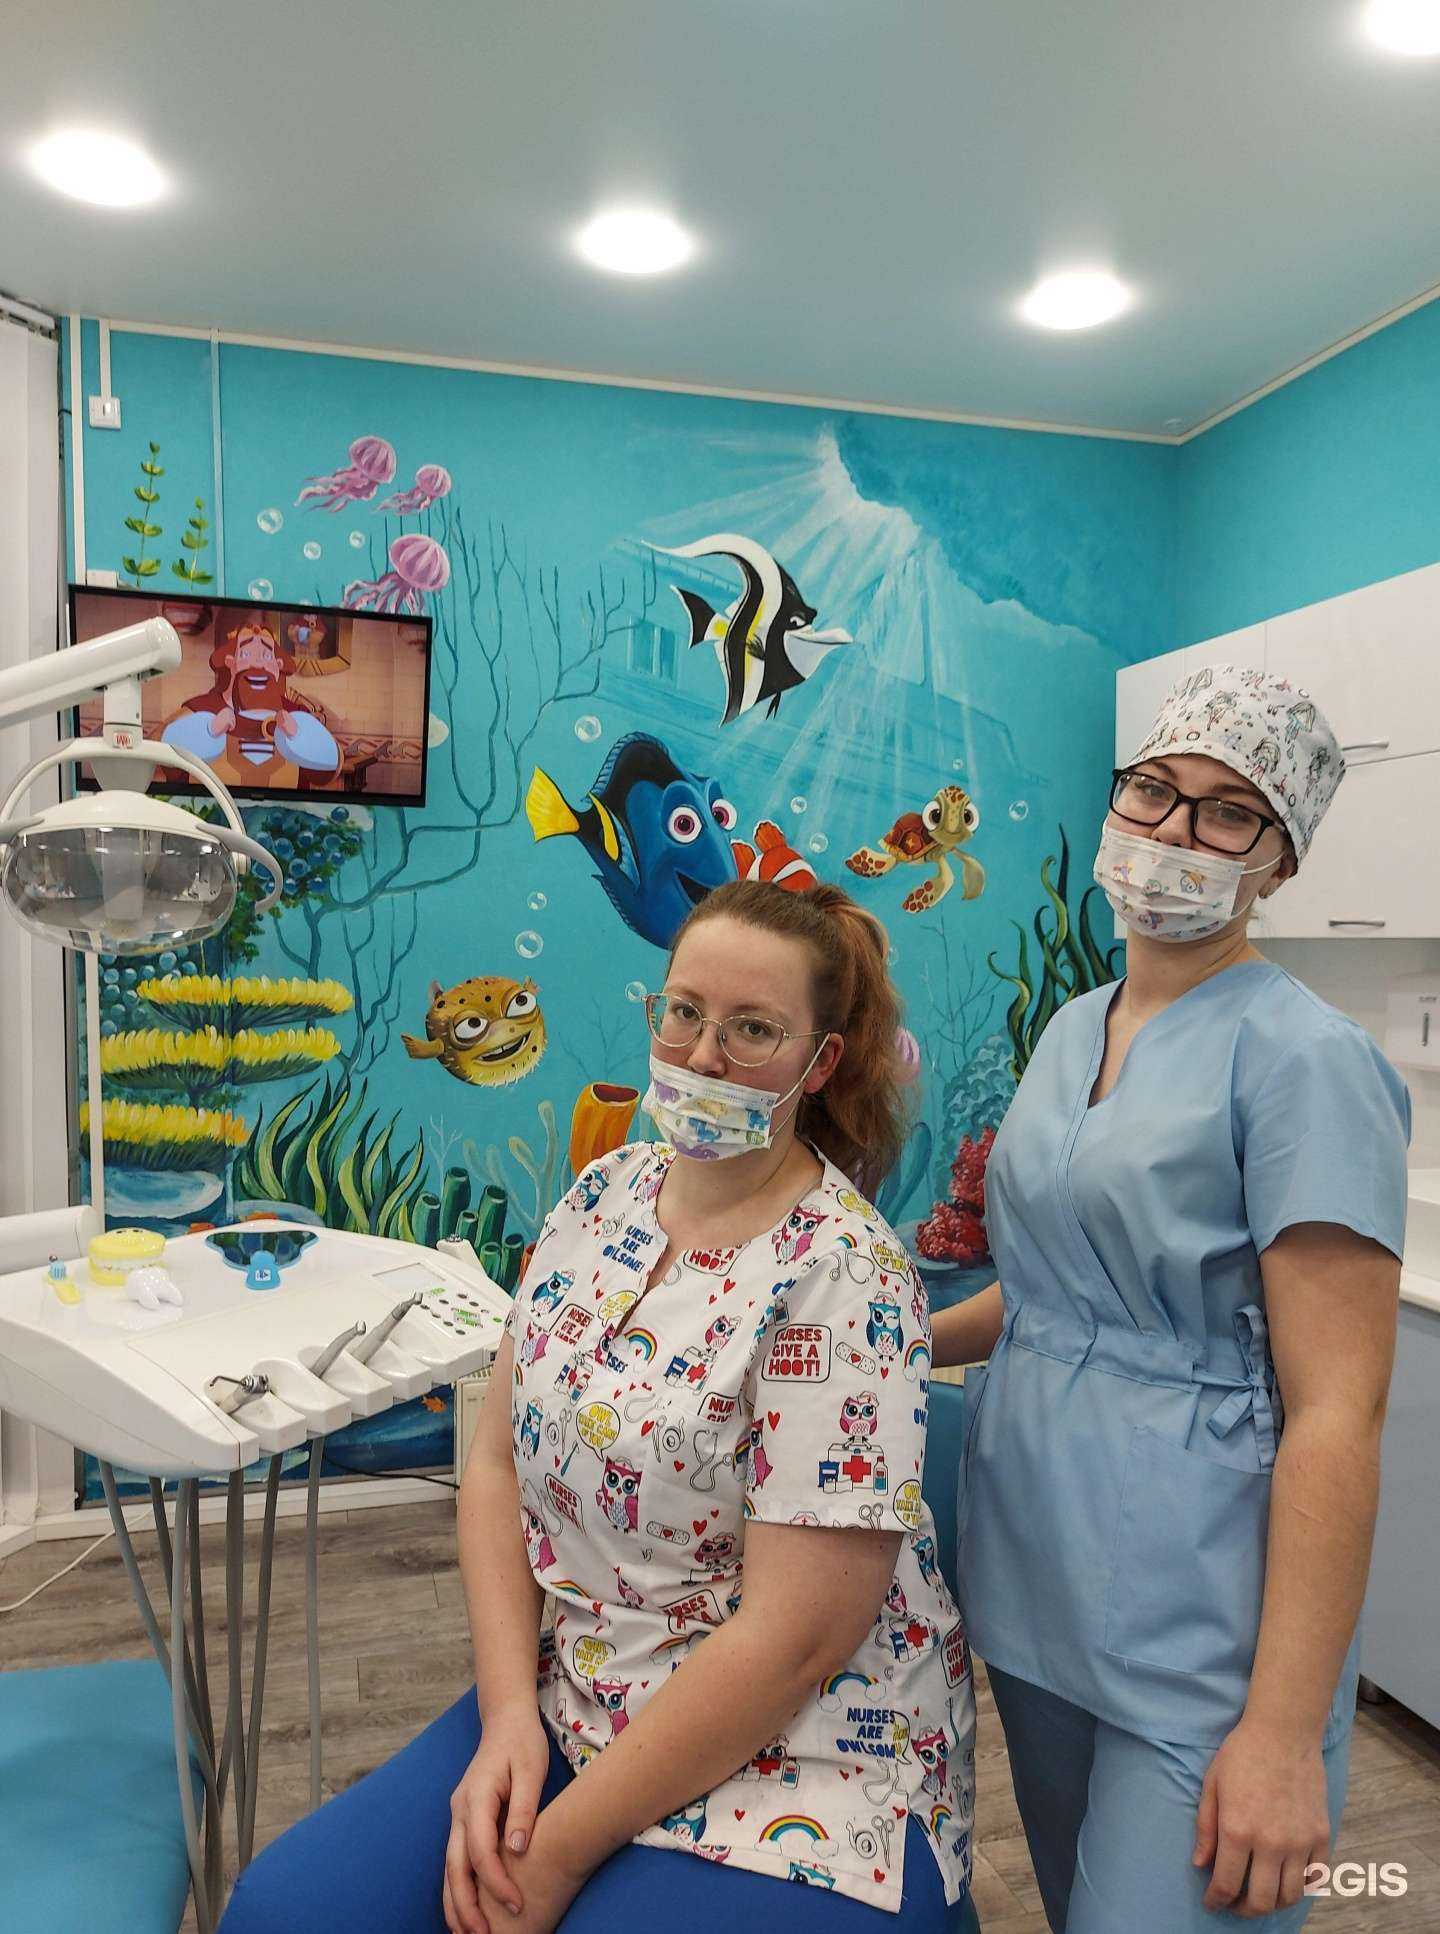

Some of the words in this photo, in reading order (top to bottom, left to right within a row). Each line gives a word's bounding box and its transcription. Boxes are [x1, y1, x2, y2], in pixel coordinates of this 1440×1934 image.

[779, 1328, 823, 1342] URSES
[772, 1344, 803, 1358] GIVE
[807, 1344, 819, 1358] A
[769, 1359, 821, 1377] HOOT!
[549, 1478, 578, 1508] NURSES
[846, 1707, 896, 1724] NURSES
[856, 1725, 885, 1739] ARE
